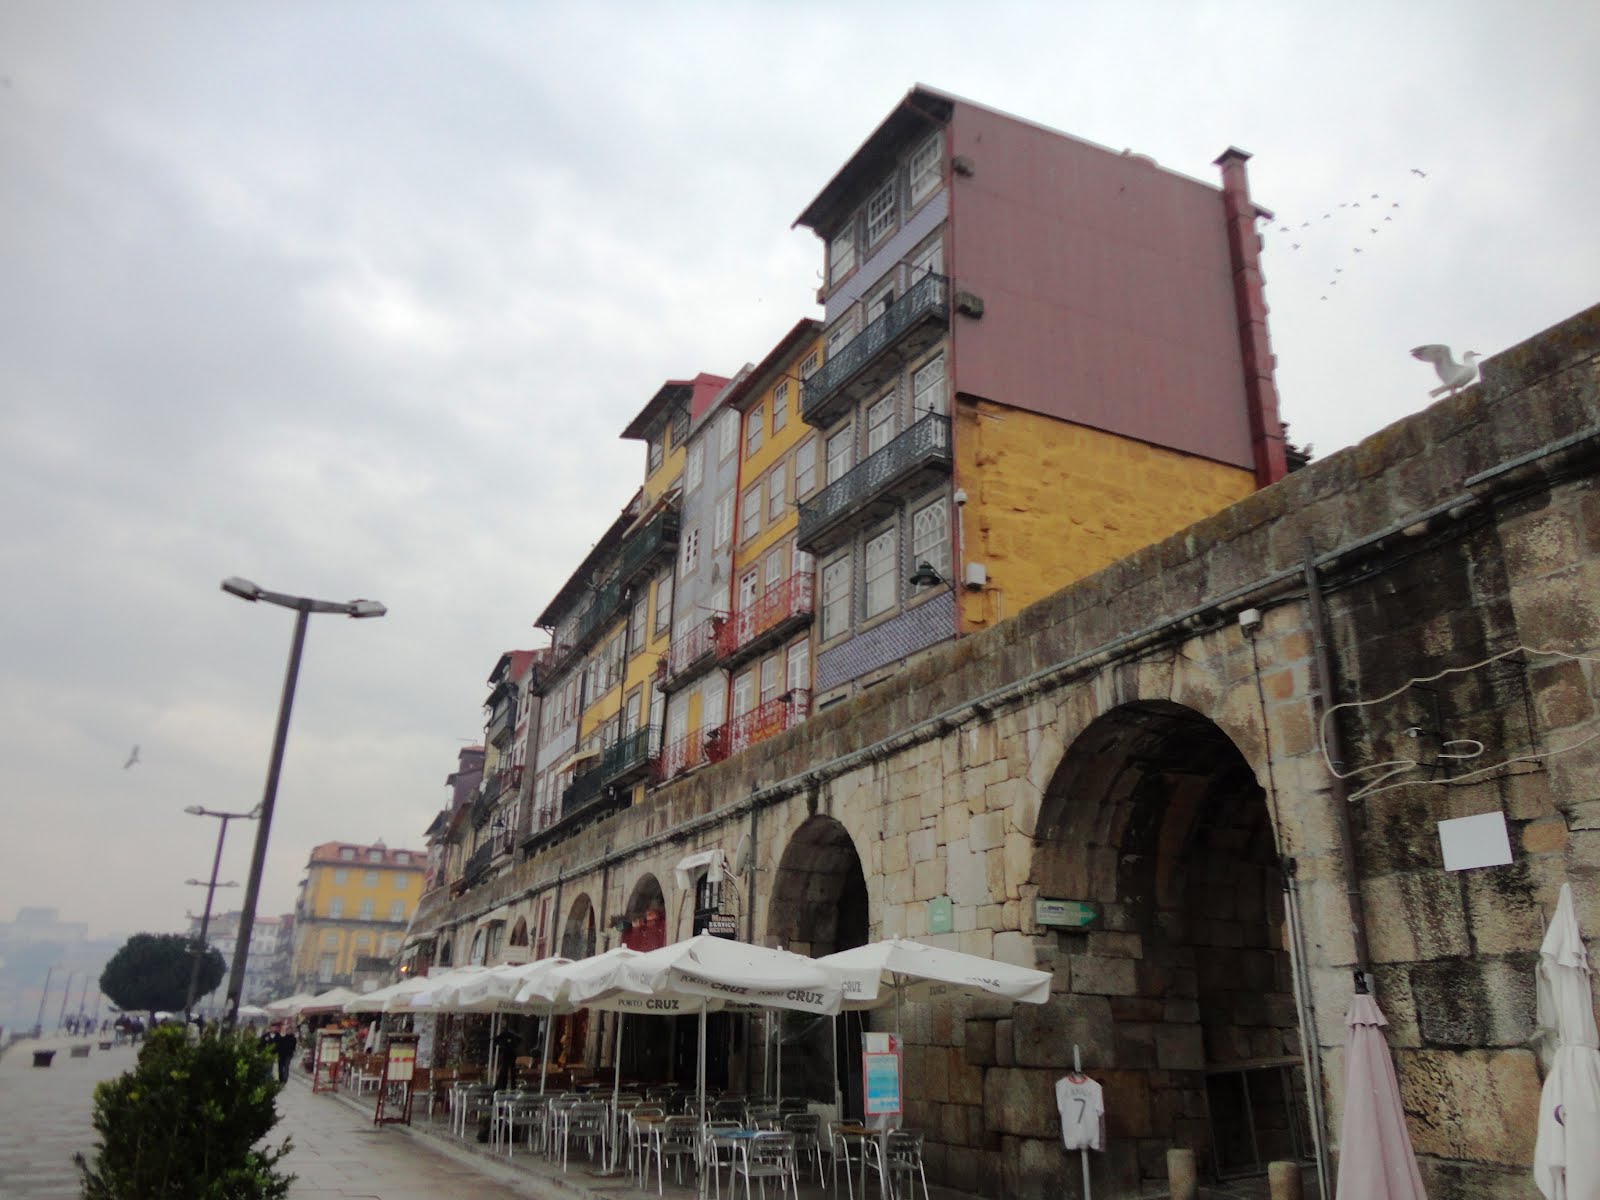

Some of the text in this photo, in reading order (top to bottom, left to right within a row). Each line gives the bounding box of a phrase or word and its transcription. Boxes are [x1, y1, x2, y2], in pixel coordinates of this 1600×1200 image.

[710, 982, 749, 995] CRUZ
[786, 989, 825, 1005] CRUZ
[618, 999, 680, 1010] PORTO CRUZ
[1073, 1098, 1086, 1124] 7
